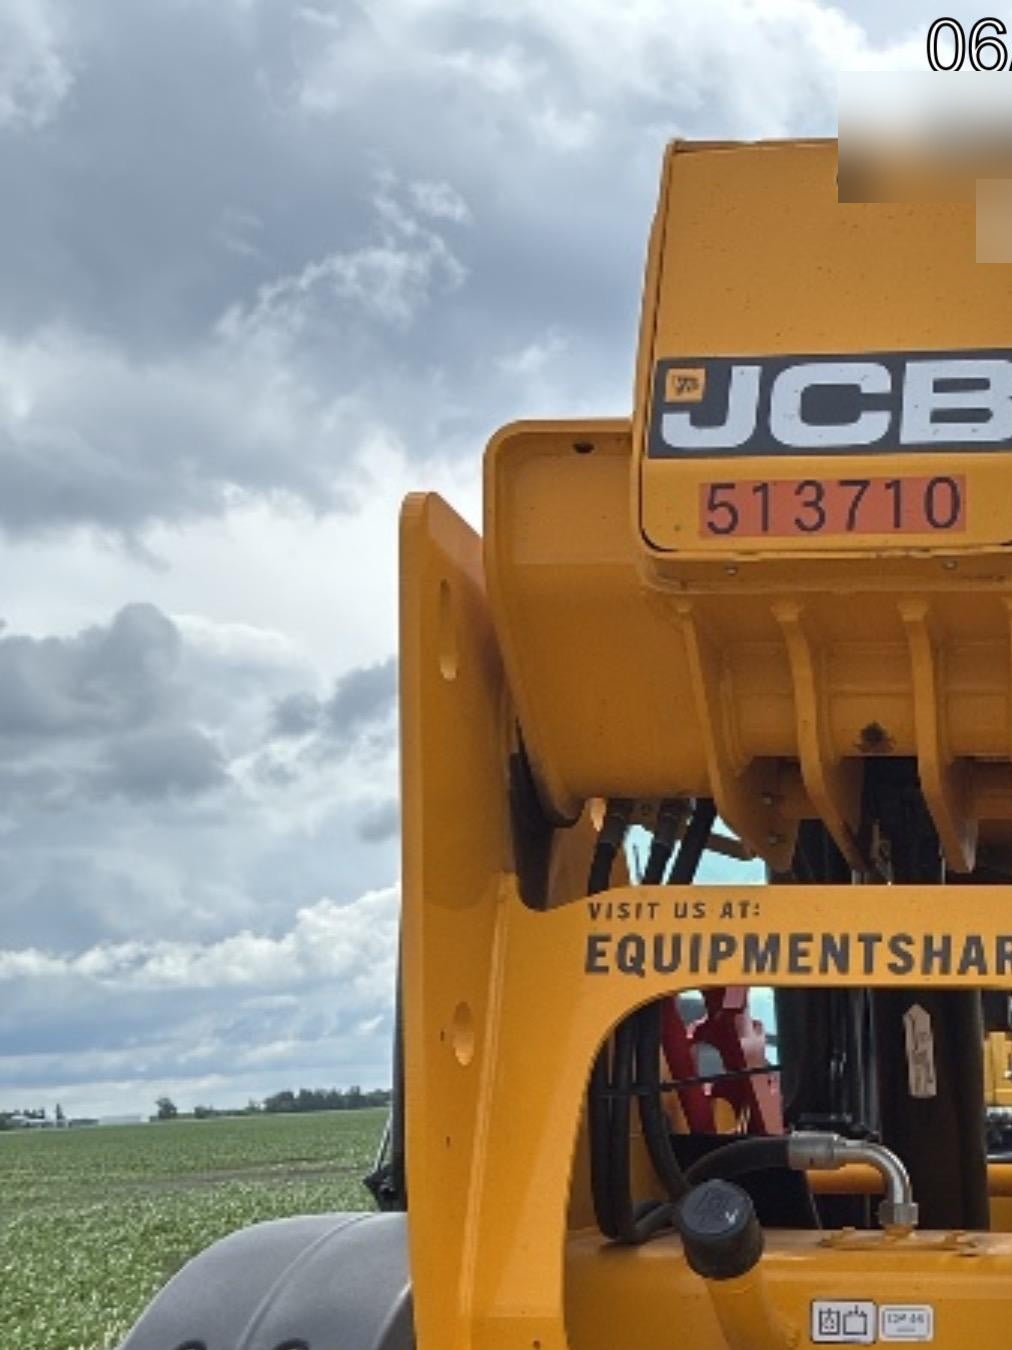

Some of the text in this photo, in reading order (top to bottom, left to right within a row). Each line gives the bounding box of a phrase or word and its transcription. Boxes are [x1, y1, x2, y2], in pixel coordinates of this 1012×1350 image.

[707, 476, 961, 535] 513710
[588, 901, 761, 921] VISIT US AT:
